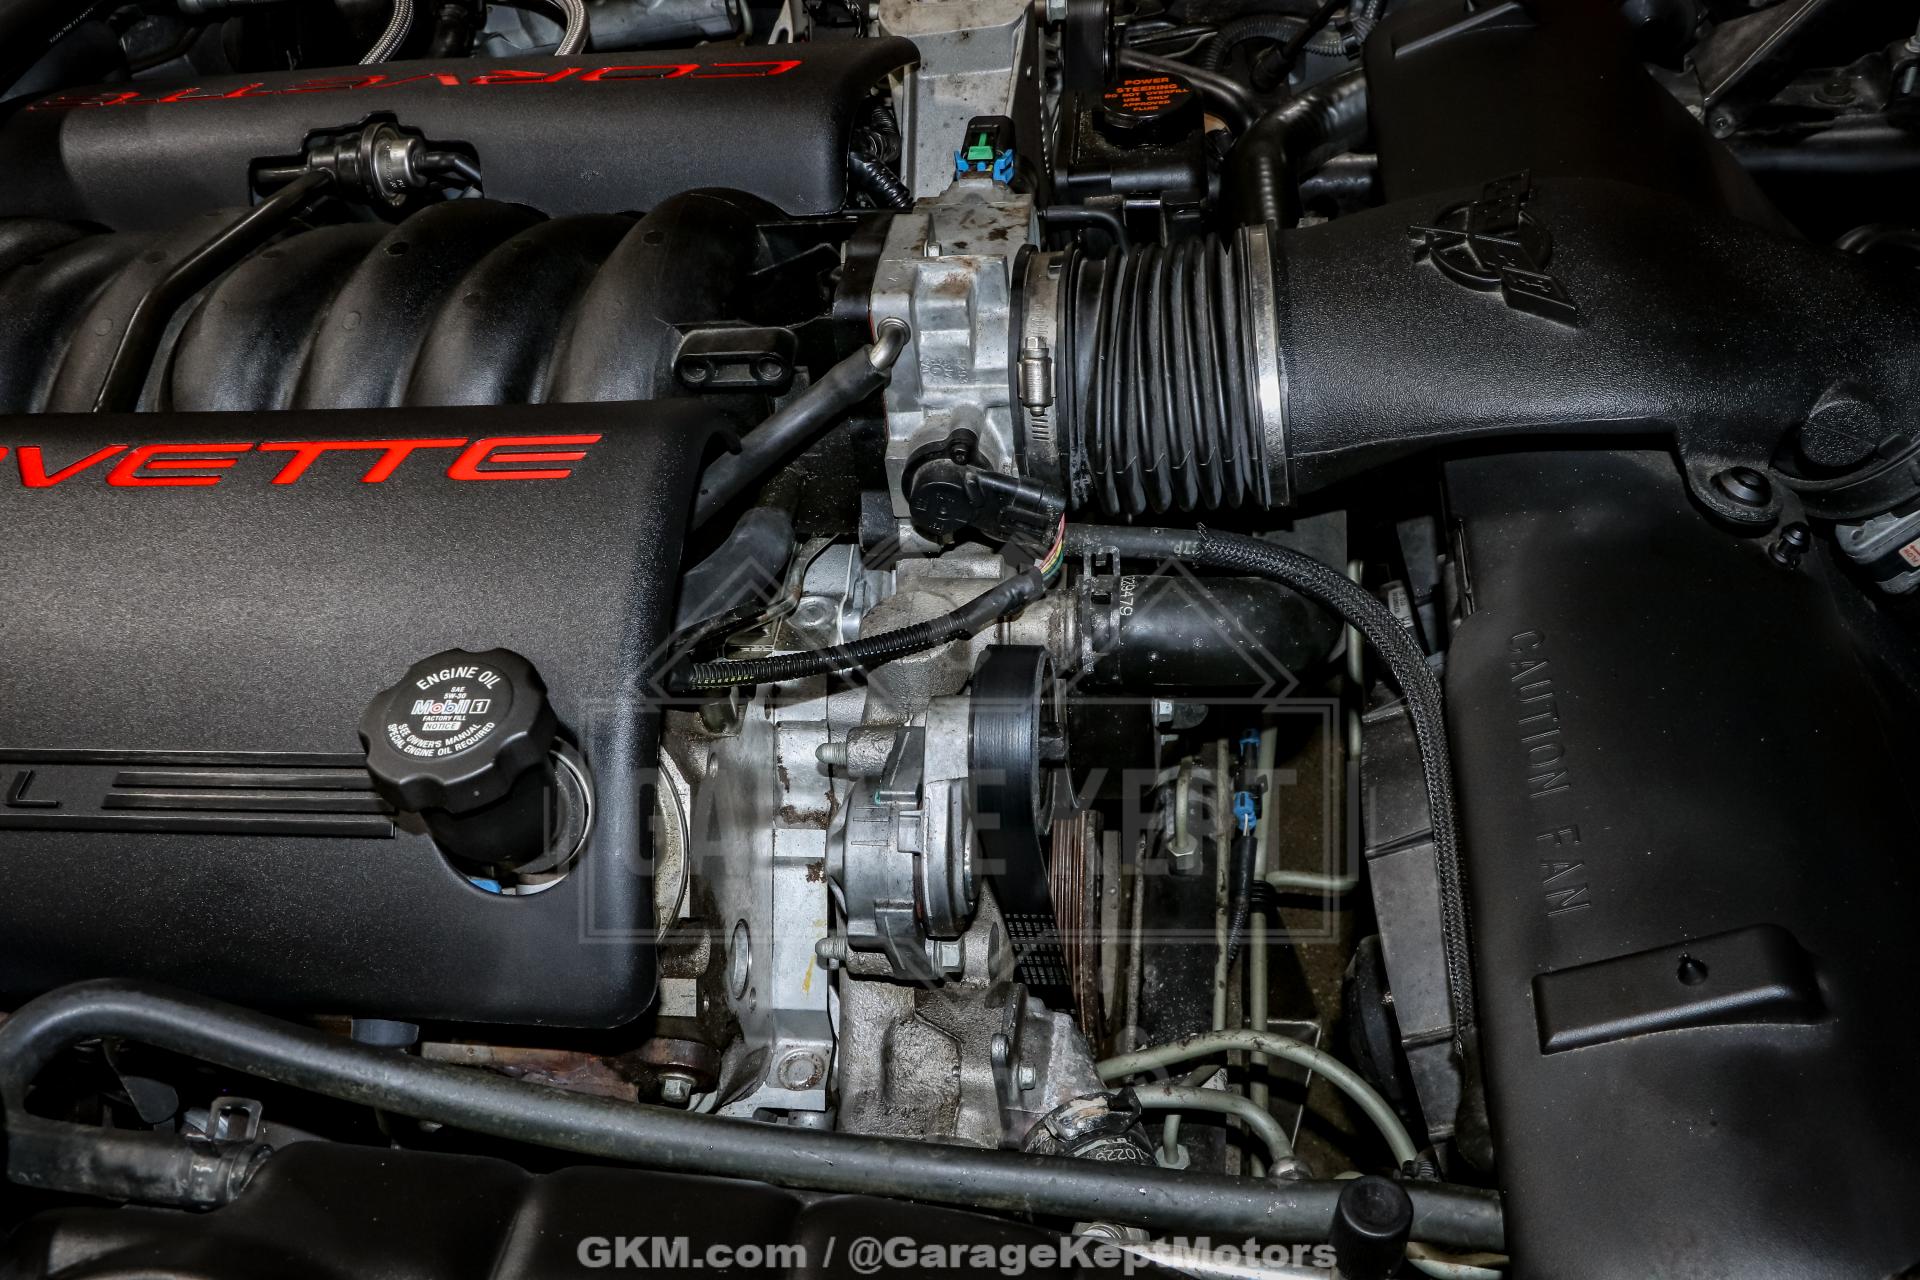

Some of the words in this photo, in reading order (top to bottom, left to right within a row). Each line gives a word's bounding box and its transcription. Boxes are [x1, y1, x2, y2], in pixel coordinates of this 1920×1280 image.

[1116, 83, 1178, 93] STEERING
[1124, 77, 1169, 85] POWER
[0, 434, 602, 487] VETTE
[416, 666, 480, 691] ENGINE
[478, 670, 501, 690] OIL
[411, 699, 471, 714] Mobil
[443, 692, 467, 700] 5W-30
[425, 722, 457, 730] NOTICE
[1509, 630, 1571, 799] CAUTION
[388, 723, 406, 750] SPECIAL
[404, 744, 435, 757] ENGINE
[437, 747, 453, 756] OIL
[455, 722, 496, 751] REQUIRED
[398, 723, 408, 738] SEE
[406, 735, 442, 749] OWNER'S
[445, 724, 482, 746] MANUAL
[1536, 824, 1592, 916] FAN
